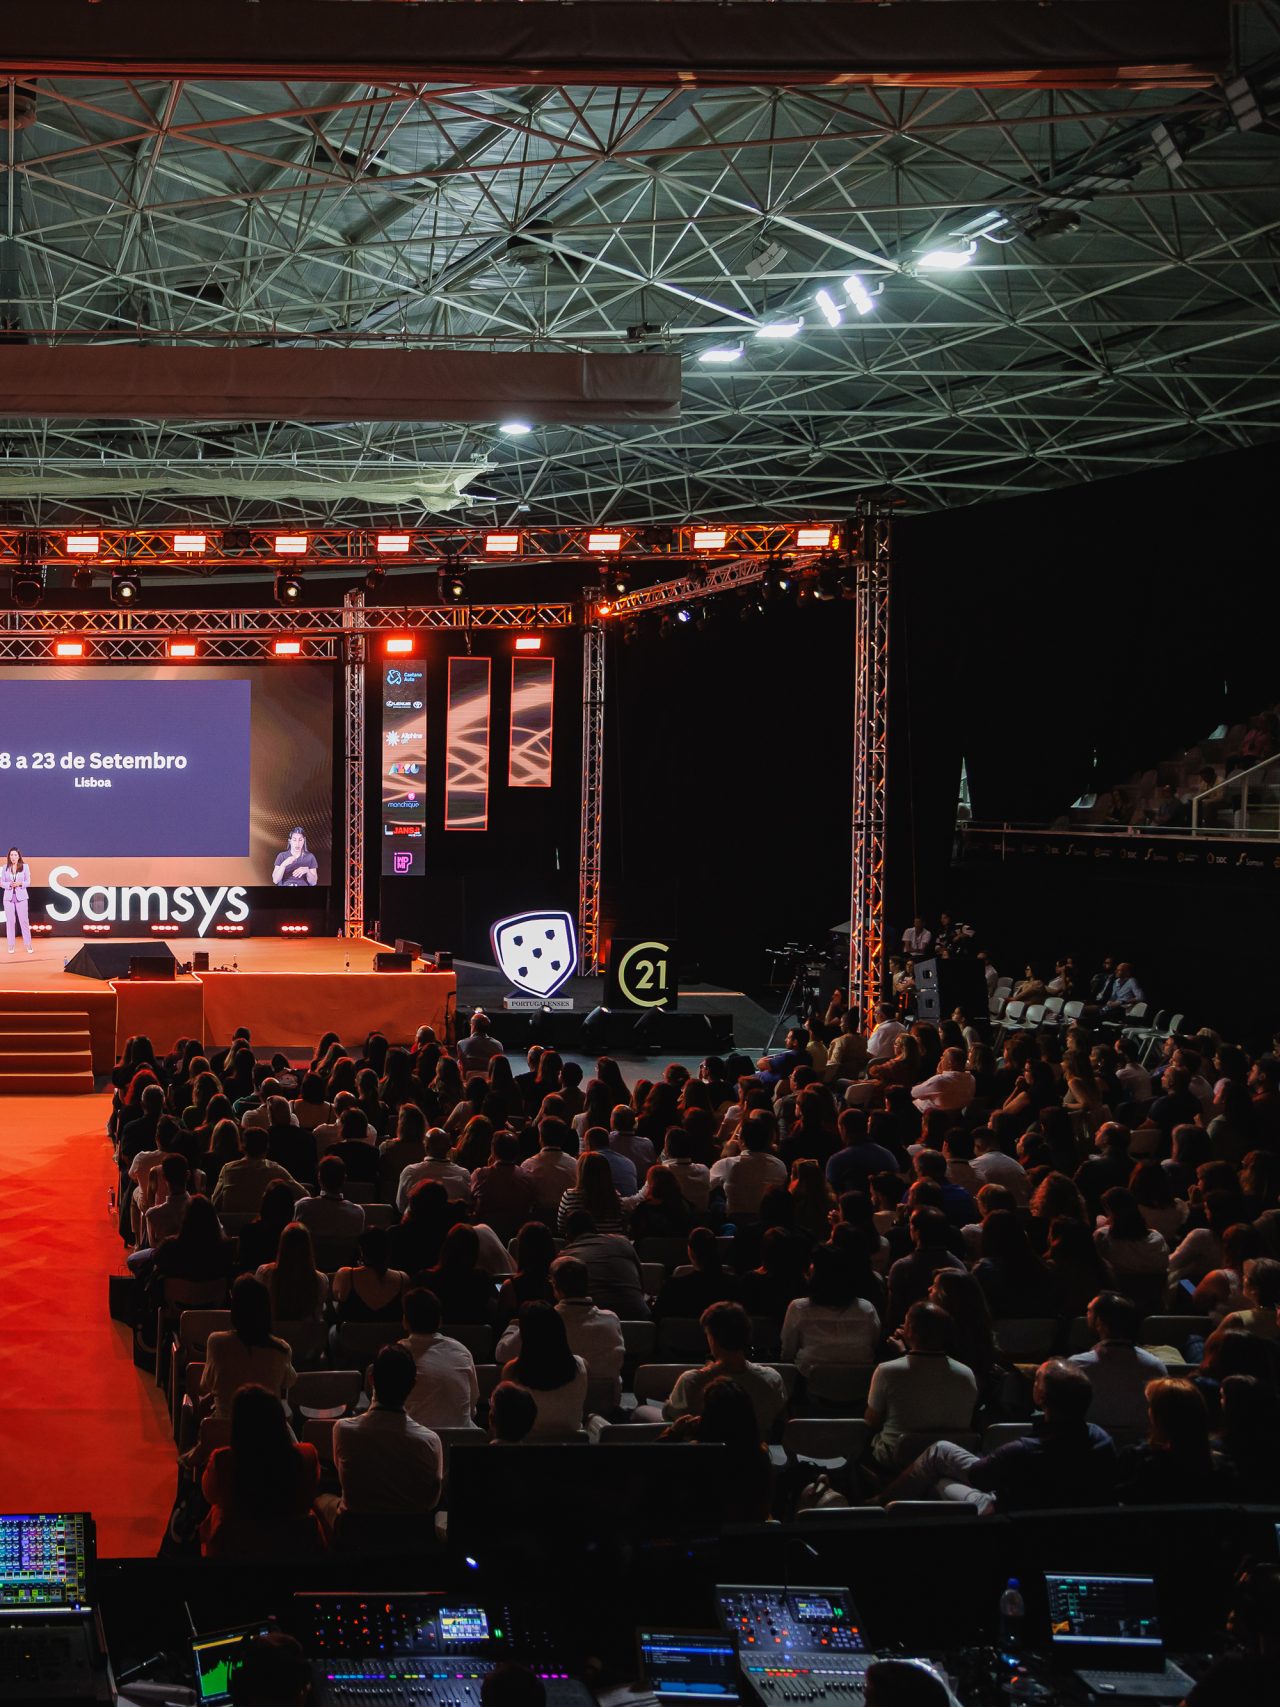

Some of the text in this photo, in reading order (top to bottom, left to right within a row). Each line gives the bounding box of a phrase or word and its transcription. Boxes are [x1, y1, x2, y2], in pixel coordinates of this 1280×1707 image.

[15, 755, 29, 770] a
[31, 752, 56, 770] 23
[60, 751, 86, 770] de
[89, 751, 188, 770] Setembro
[74, 776, 112, 788] Lisboa
[387, 801, 420, 809] monchique
[45, 865, 250, 938] Samsys
